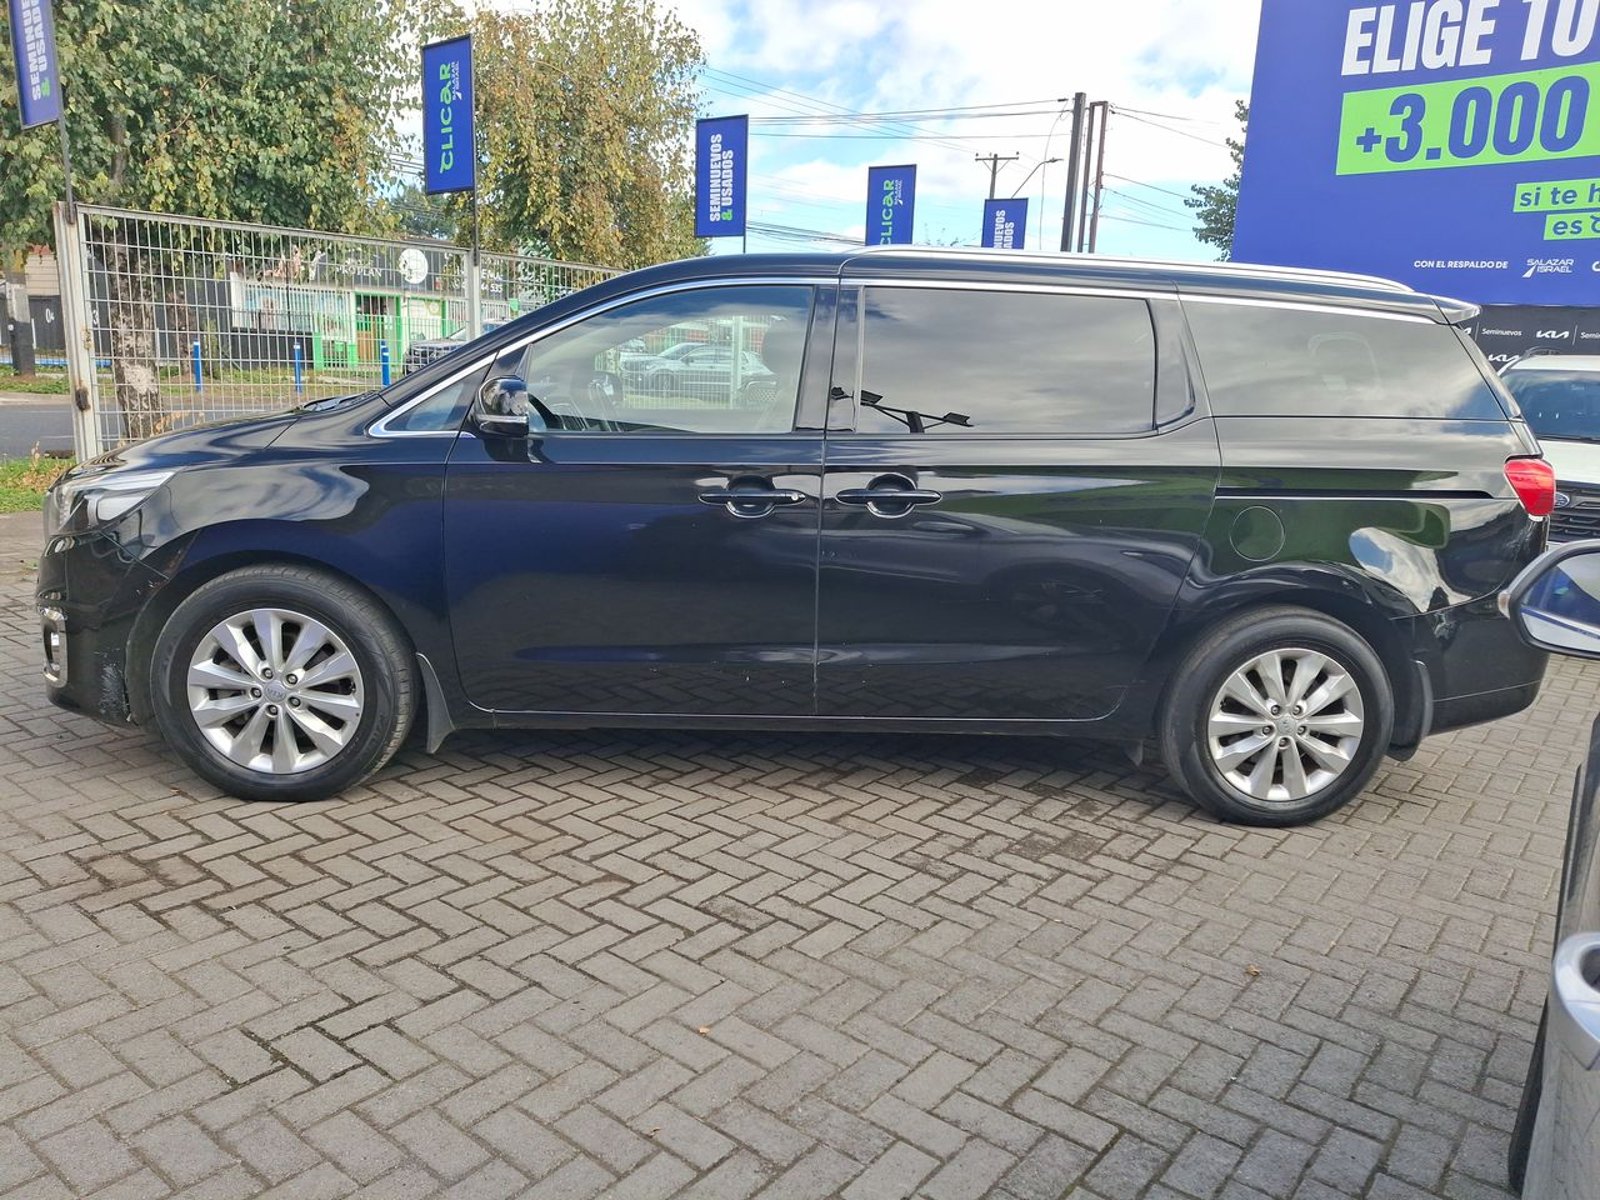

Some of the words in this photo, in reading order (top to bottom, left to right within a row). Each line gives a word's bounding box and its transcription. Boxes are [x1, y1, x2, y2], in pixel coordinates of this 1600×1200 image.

[21, 0, 41, 100] SEMINUE
[30, 0, 47, 72] USAD
[1341, 0, 1500, 76] ELIGE
[1356, 75, 1590, 163] +3.000
[710, 133, 722, 222] SEMINUEVOS
[721, 149, 734, 207] USADOS
[1519, 187, 1541, 206] si
[1551, 187, 1577, 205] te
[720, 209, 733, 221] &
[993, 209, 1006, 249] NUEVOS
[1553, 220, 1582, 235] es
[1003, 221, 1015, 249] ADOS
[1414, 260, 1435, 268] CON
[1436, 260, 1446, 268] EL
[1447, 260, 1494, 269] RESPALDO
[1495, 261, 1509, 269] DE
[1481, 327, 1522, 337] Seminuevos
[1536, 330, 1569, 339] KIA
